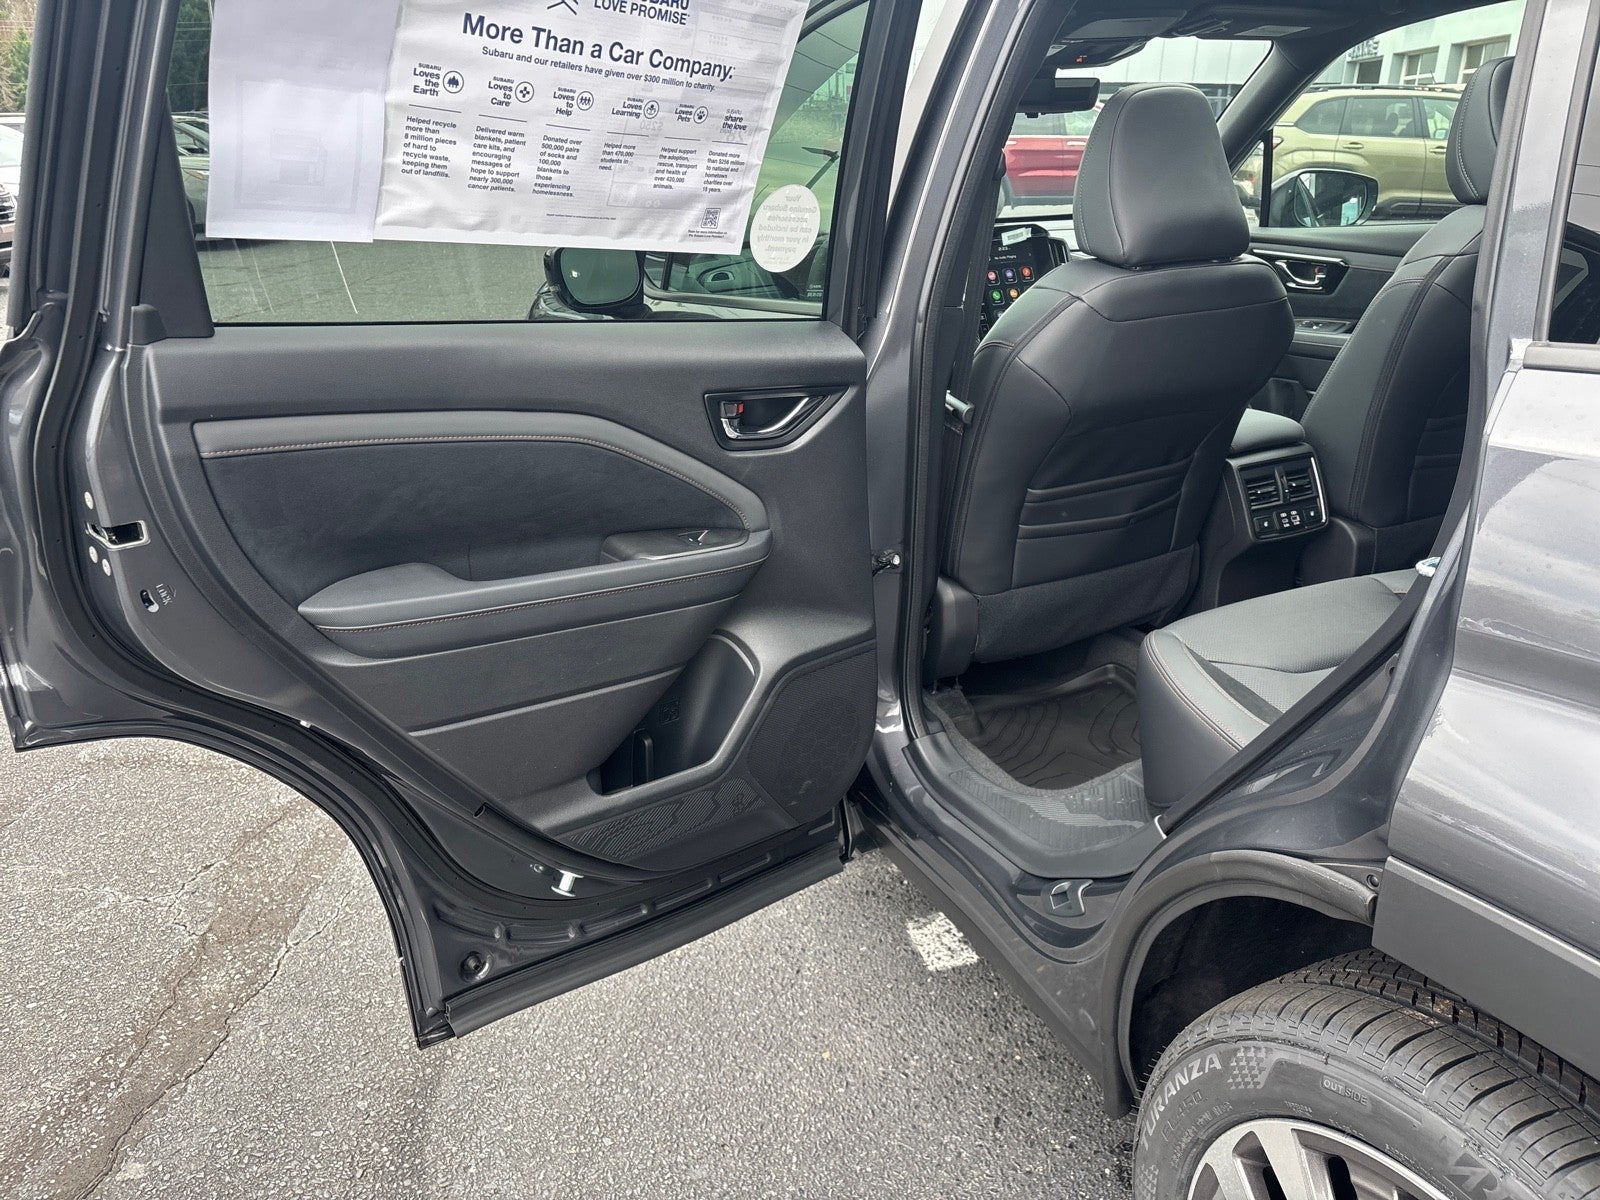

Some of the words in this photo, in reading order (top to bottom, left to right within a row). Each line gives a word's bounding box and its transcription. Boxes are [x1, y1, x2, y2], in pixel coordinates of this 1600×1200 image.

[594, 0, 627, 13] LOVE
[630, 3, 687, 25] PROMISE
[463, 13, 523, 44] More
[532, 26, 584, 56] Than
[591, 42, 602, 58] a
[609, 42, 644, 65] Car
[649, 49, 734, 82] Company.
[418, 63, 441, 71] SUBARU
[482, 46, 514, 60] Subaru
[516, 51, 532, 63] and
[534, 56, 549, 66] our
[550, 58, 582, 72] retailers
[584, 63, 603, 75] have
[604, 67, 624, 80] given
[626, 72, 643, 81] over
[644, 73, 660, 84] $300
[662, 76, 684, 87] million
[686, 80, 692, 88] to
[694, 82, 715, 92] charity.
[413, 68, 440, 80] Loves
[425, 79, 439, 88] the
[488, 81, 513, 92] Loves
[413, 85, 439, 97] Earth
[553, 92, 575, 101] Loves
[490, 97, 510, 107] Care
[623, 102, 642, 110] Loves
[555, 108, 572, 117] Help
[611, 108, 640, 119] Learning
[675, 108, 692, 116] Loves
[406, 116, 431, 125] Helped
[432, 120, 456, 129] recycle
[724, 115, 743, 123] share
[405, 125, 424, 133] more
[425, 126, 440, 135] than
[476, 126, 506, 135] Delivered
[733, 123, 747, 131] love
[411, 133, 433, 142] million
[435, 136, 456, 145] pieces
[474, 134, 503, 144] blankets,
[504, 138, 526, 146] patient
[543, 135, 568, 143] Donated
[412, 142, 428, 150] hard
[489, 144, 501, 152] kits,
[541, 143, 564, 151] 500,000
[403, 150, 427, 160] recycle
[429, 153, 450, 162] waste,
[472, 151, 511, 161] encouraging
[402, 159, 429, 169] keeping
[431, 162, 447, 170] them
[472, 159, 502, 169] messages
[539, 158, 561, 166] 100,000
[422, 170, 450, 178] landfills.
[470, 167, 486, 175] hope
[496, 170, 520, 178] support
[537, 166, 562, 174] blankets
[469, 175, 488, 183] nearly
[490, 177, 513, 185] 300,000
[490, 184, 516, 192] patients.
[534, 182, 570, 190] experiencing
[532, 189, 574, 197] homelessness.
[1141, 1053, 1222, 1151] TURANZA
